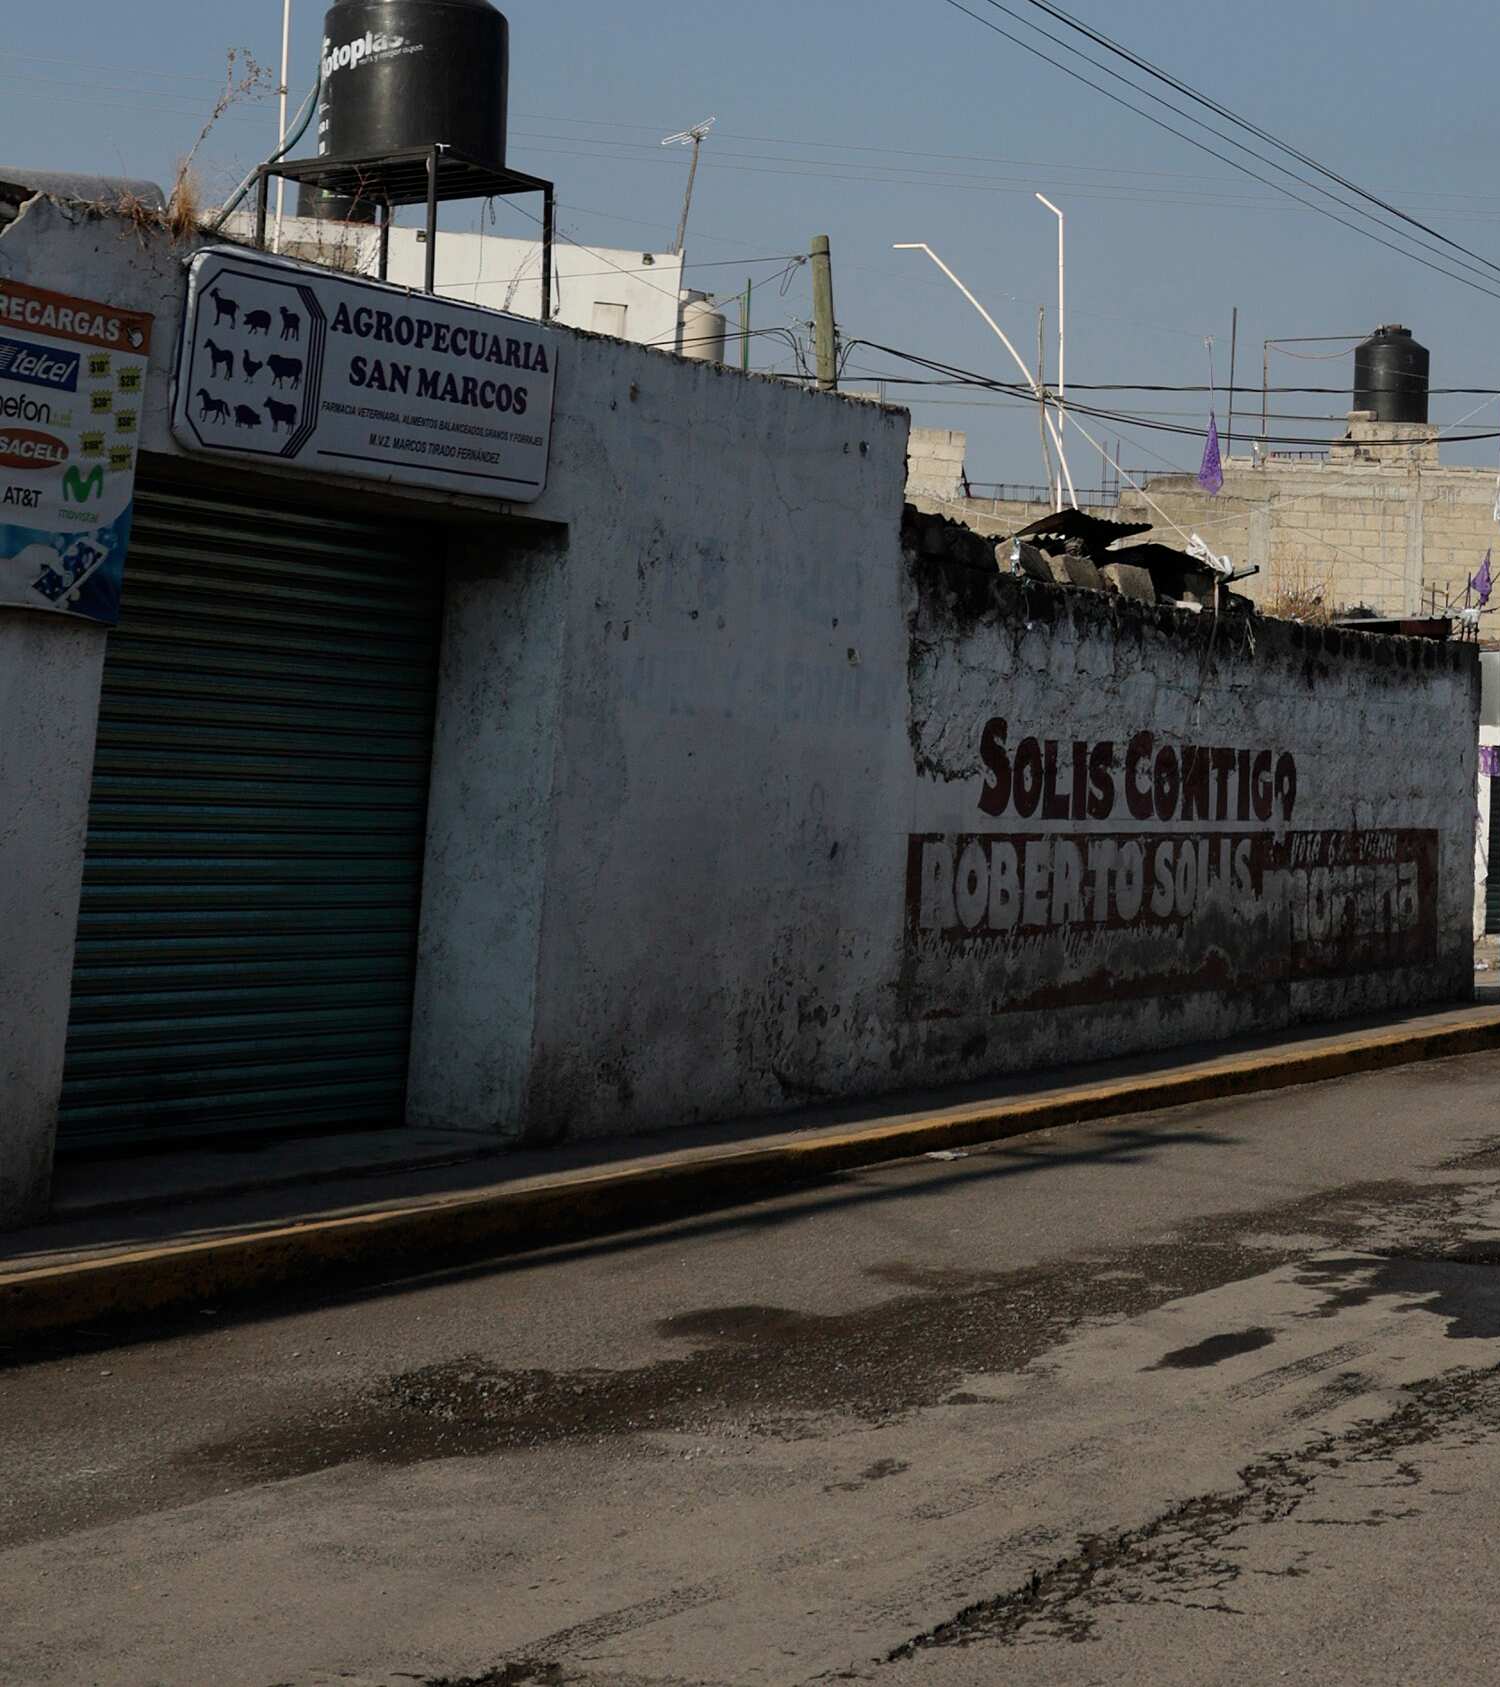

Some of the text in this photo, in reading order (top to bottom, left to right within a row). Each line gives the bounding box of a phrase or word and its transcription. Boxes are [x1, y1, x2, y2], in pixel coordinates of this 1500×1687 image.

[321, 30, 404, 80] otoplas
[331, 302, 549, 373] AGROPECUARIA
[10, 349, 77, 383] telcel
[349, 355, 528, 415] SAN MARCOS
[0, 393, 50, 425] efon
[321, 401, 355, 415] FARMACIA
[402, 415, 438, 429] ALIMENTOS
[392, 437, 426, 453] MARCOS
[428, 443, 455, 457] TIRADO
[3, 486, 42, 508] AT&T
[977, 717, 1296, 821] SOLIS CONTIGO
[919, 837, 1252, 928] ROBERTO SOLIS
